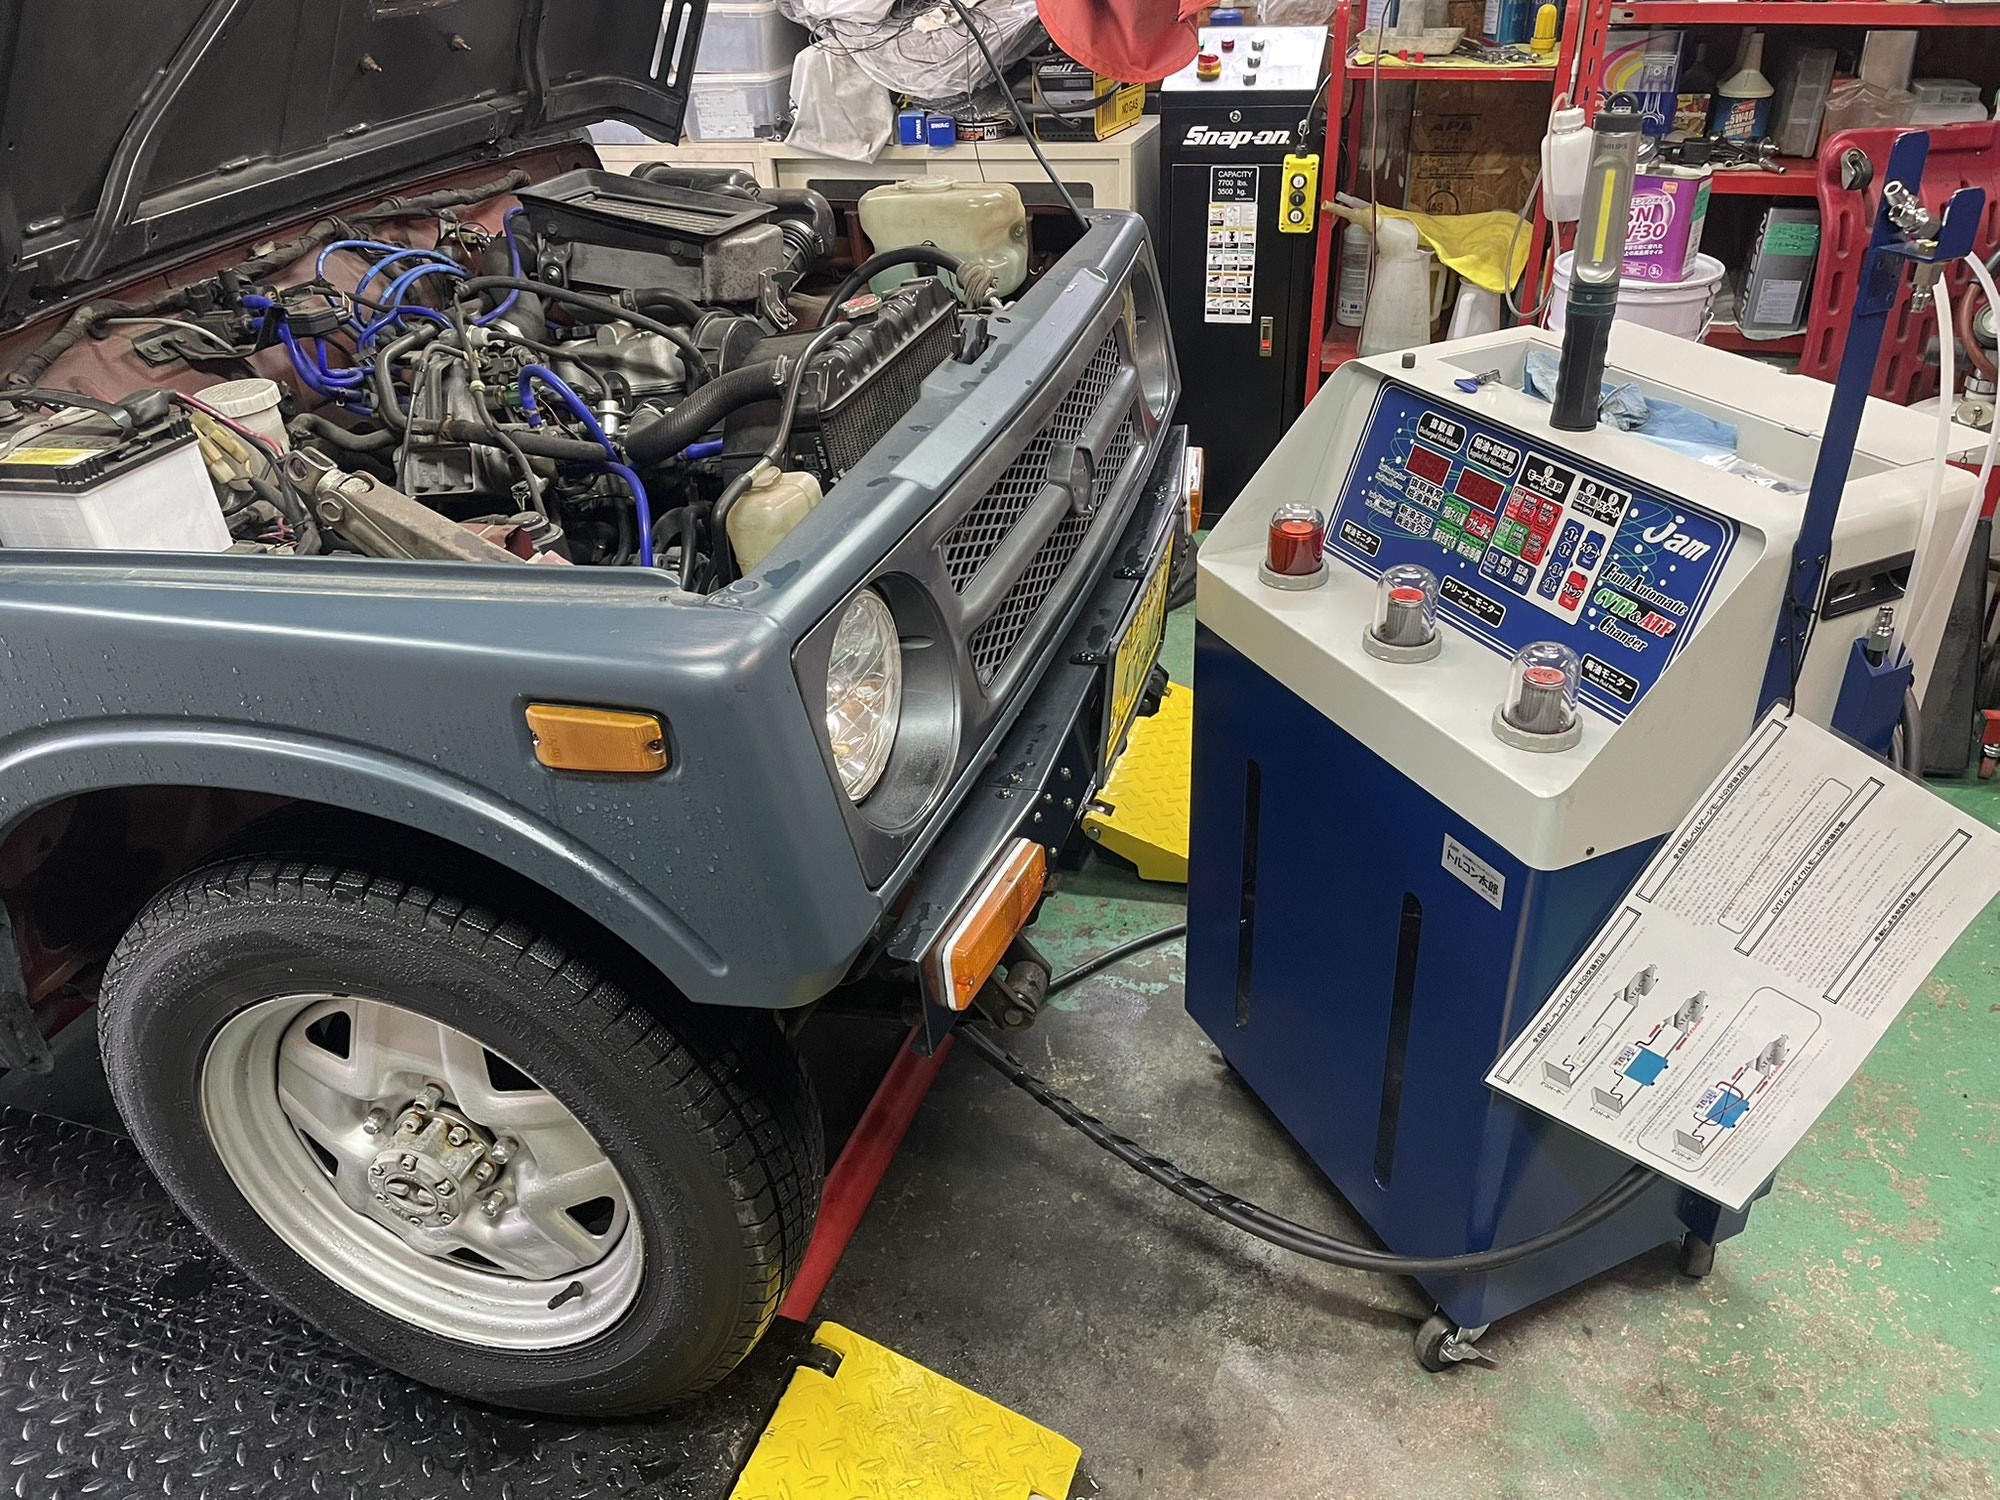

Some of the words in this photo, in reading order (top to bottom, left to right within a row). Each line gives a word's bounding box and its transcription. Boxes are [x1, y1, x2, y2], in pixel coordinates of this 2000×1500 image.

[1730, 110, 1754, 125] 5W40
[986, 128, 995, 136] M
[1237, 188, 1246, 196] kg.
[1527, 469, 1564, 494] モード選択
[1597, 501, 1621, 518] スタート
[1580, 542, 1601, 558] スタート
[1445, 581, 1501, 616] クリーナーモニター
[1562, 583, 1584, 598] ストップ
[1602, 562, 1624, 589] Full
[1626, 574, 1688, 617] Automatic
[1594, 588, 1638, 619] CVTF
[1638, 611, 1677, 639] ATF
[1598, 616, 1648, 653] Changer
[1585, 660, 1633, 690] 廃油モニター
[1447, 850, 1498, 895] トルコン太郎
[1874, 891, 1917, 942] 手動による交換方法
